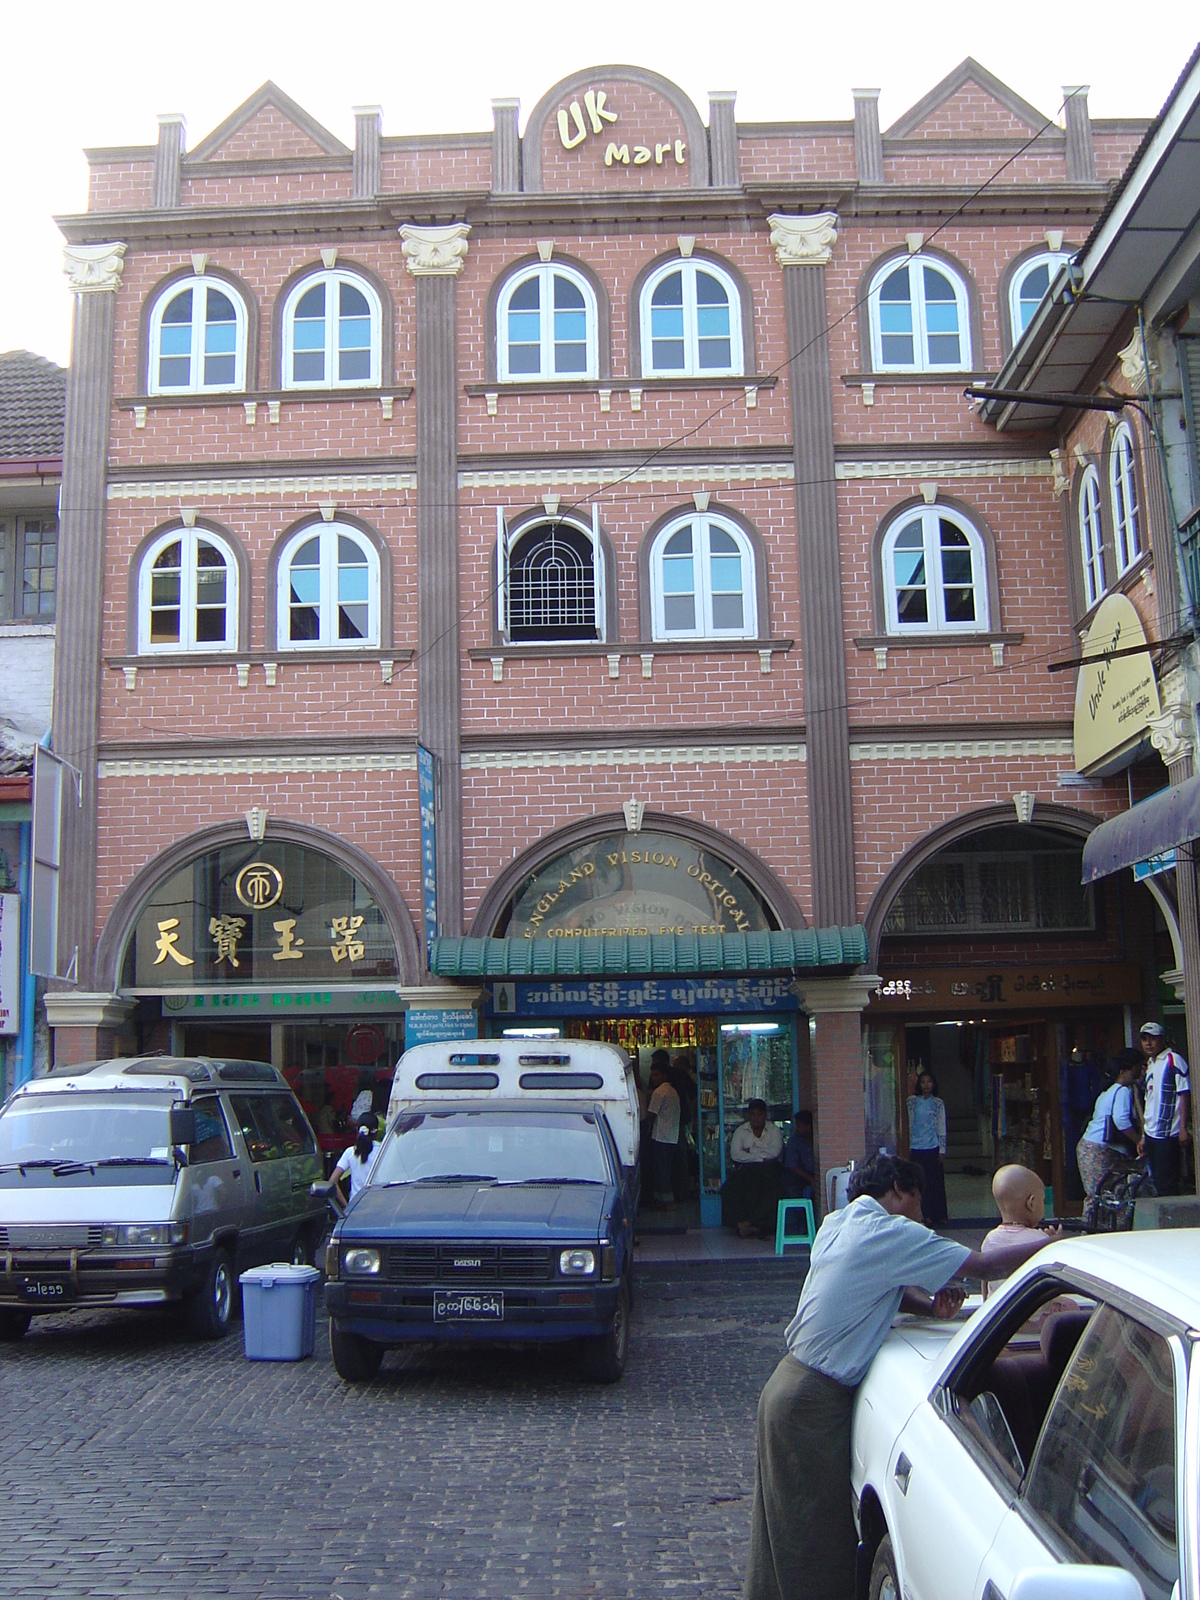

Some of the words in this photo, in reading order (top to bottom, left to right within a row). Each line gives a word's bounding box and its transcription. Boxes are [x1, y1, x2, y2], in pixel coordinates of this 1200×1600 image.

[557, 90, 618, 150] UK
[604, 139, 686, 167] Mart
[523, 862, 596, 939] ENGLAND
[606, 850, 680, 869] VISION
[687, 864, 751, 932] OPTICAL
[353, 991, 401, 1005] Jewe
[453, 1259, 481, 1267] DATSUN
